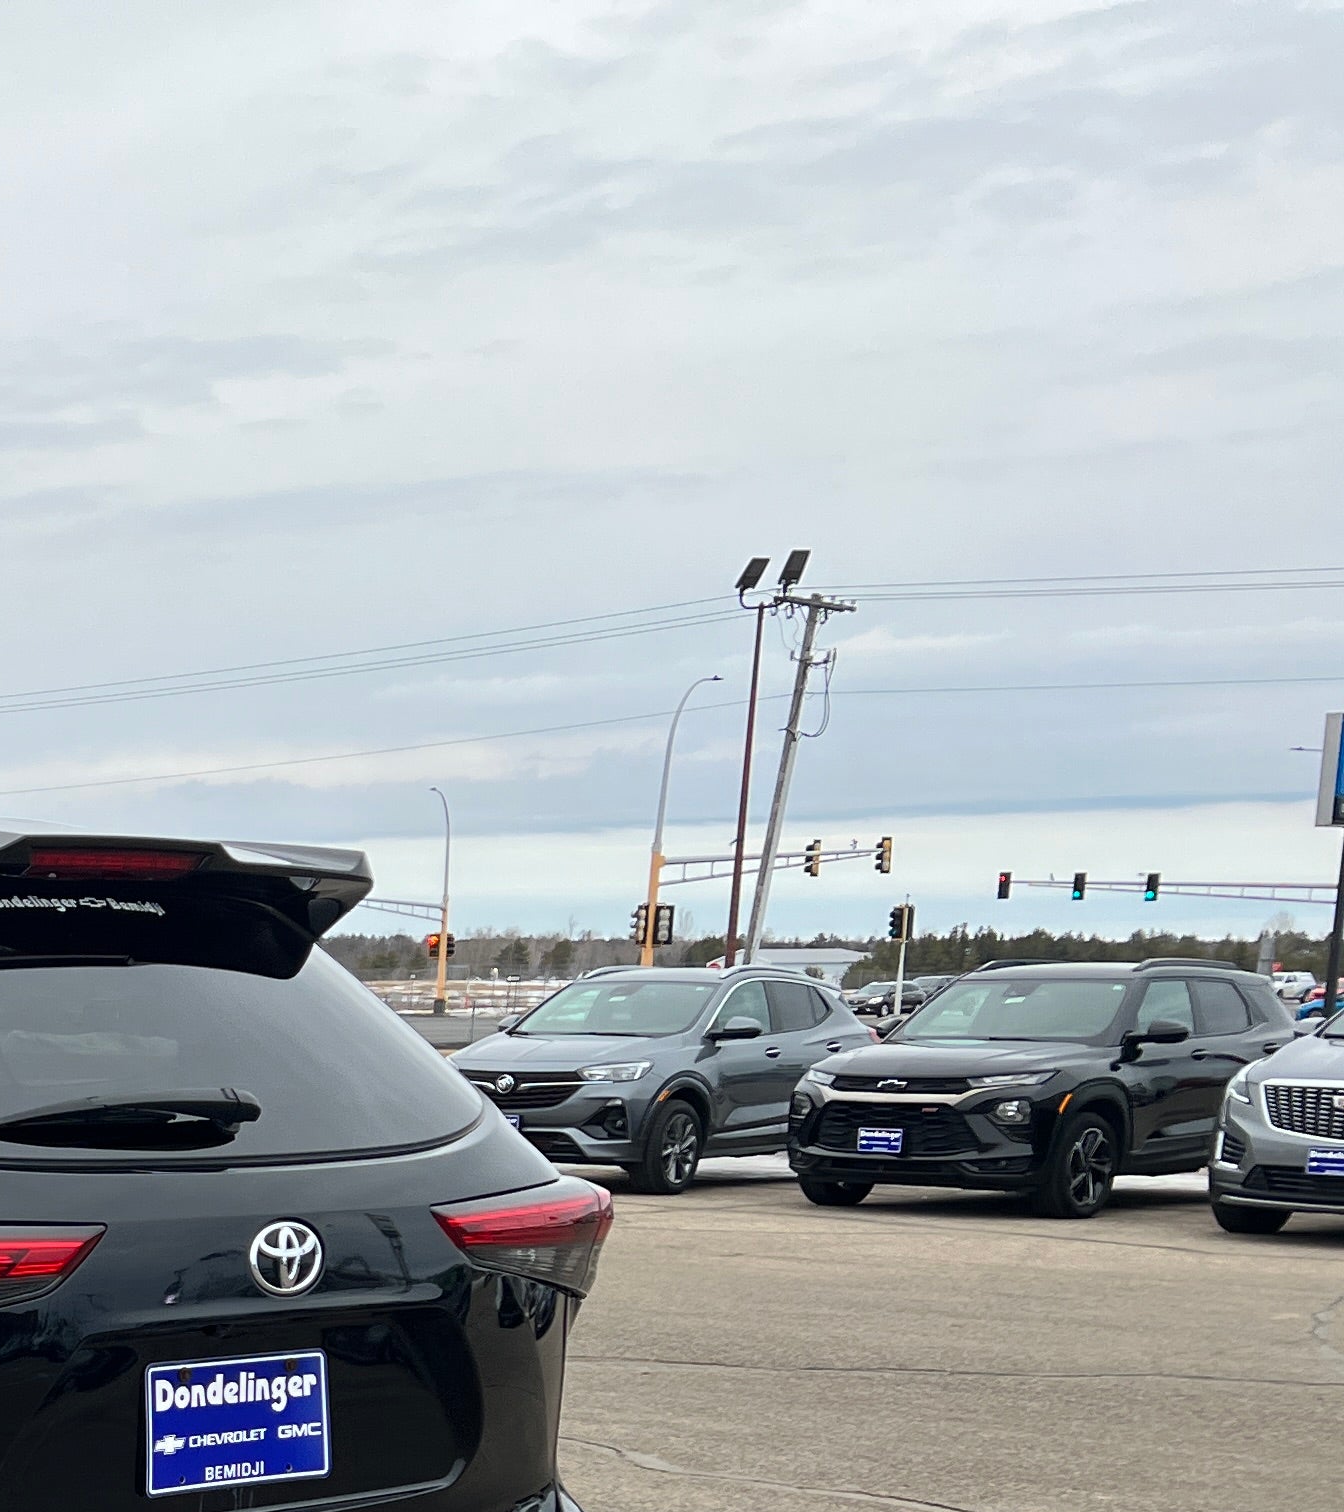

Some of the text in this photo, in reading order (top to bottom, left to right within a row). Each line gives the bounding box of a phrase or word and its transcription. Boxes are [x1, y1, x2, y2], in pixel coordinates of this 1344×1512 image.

[154, 1371, 317, 1412] Dondelinger
[188, 1422, 322, 1448] CHEVROLET GMC
[204, 1460, 265, 1481] BEMIDJI
